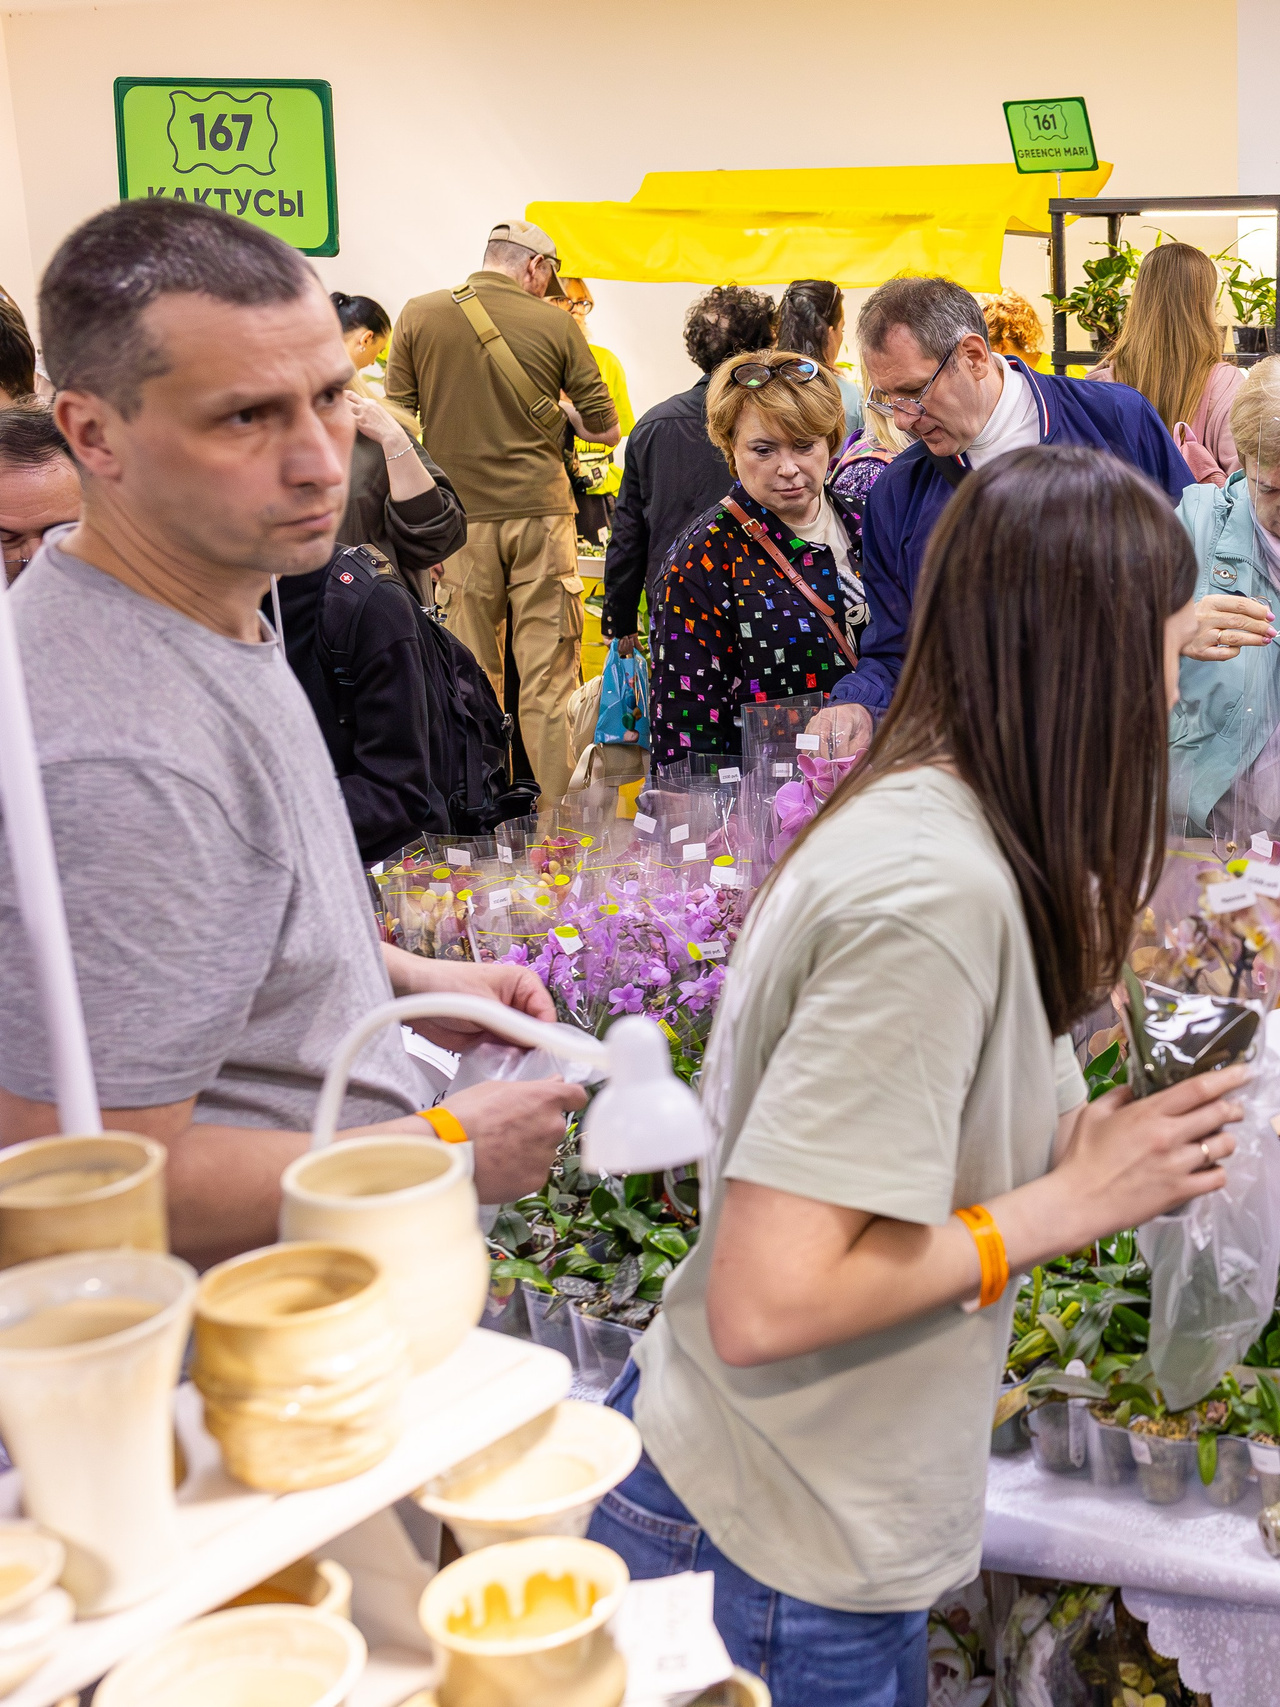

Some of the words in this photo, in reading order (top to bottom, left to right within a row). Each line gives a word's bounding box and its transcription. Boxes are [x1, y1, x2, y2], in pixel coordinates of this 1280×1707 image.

[1033, 113, 1057, 131] 161
[189, 112, 253, 152] 167
[1017, 147, 1062, 159] GREENCH
[1063, 146, 1089, 157] MARI
